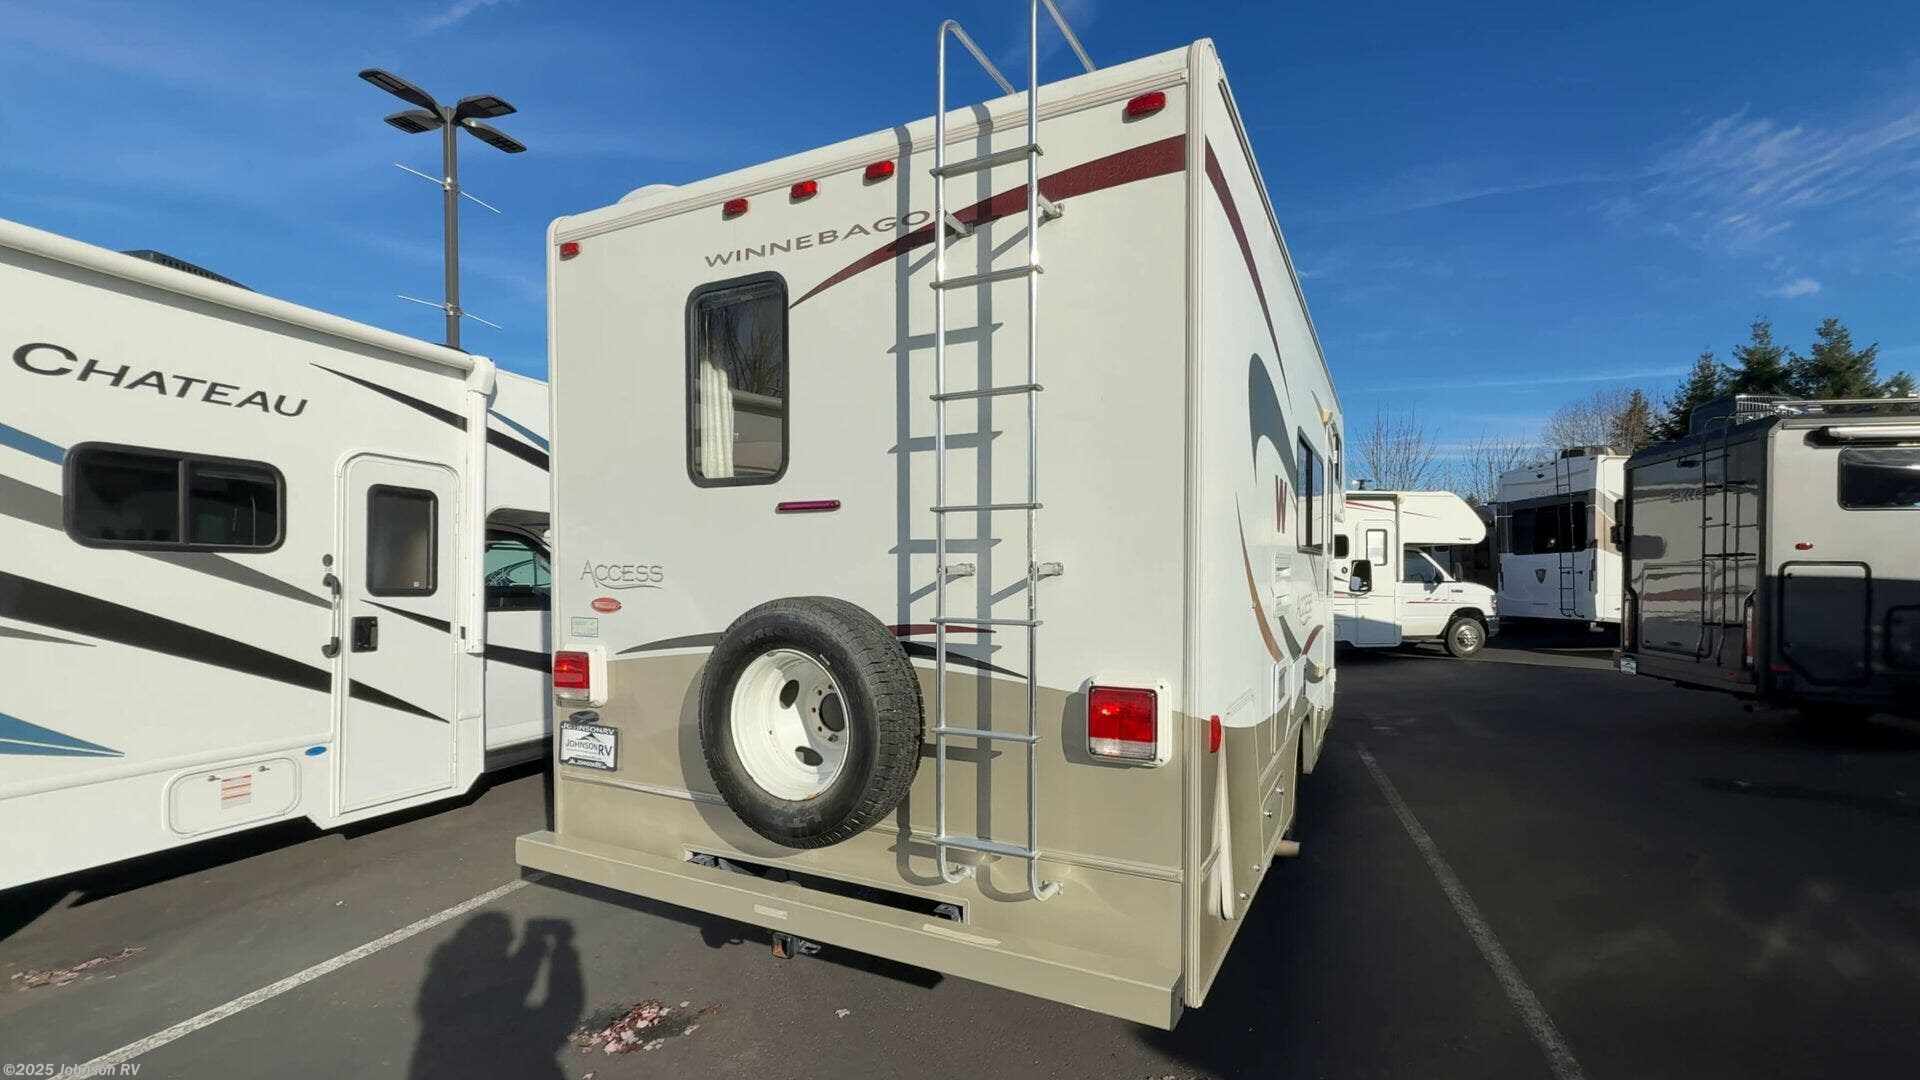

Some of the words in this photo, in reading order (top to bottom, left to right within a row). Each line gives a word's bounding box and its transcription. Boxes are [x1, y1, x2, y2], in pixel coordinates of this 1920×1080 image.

[704, 210, 931, 268] WINNEBAGO
[12, 342, 308, 417] CHATEAU
[580, 559, 664, 589] ACCESS
[565, 739, 598, 751] JOHNSON
[598, 744, 613, 757] RV
